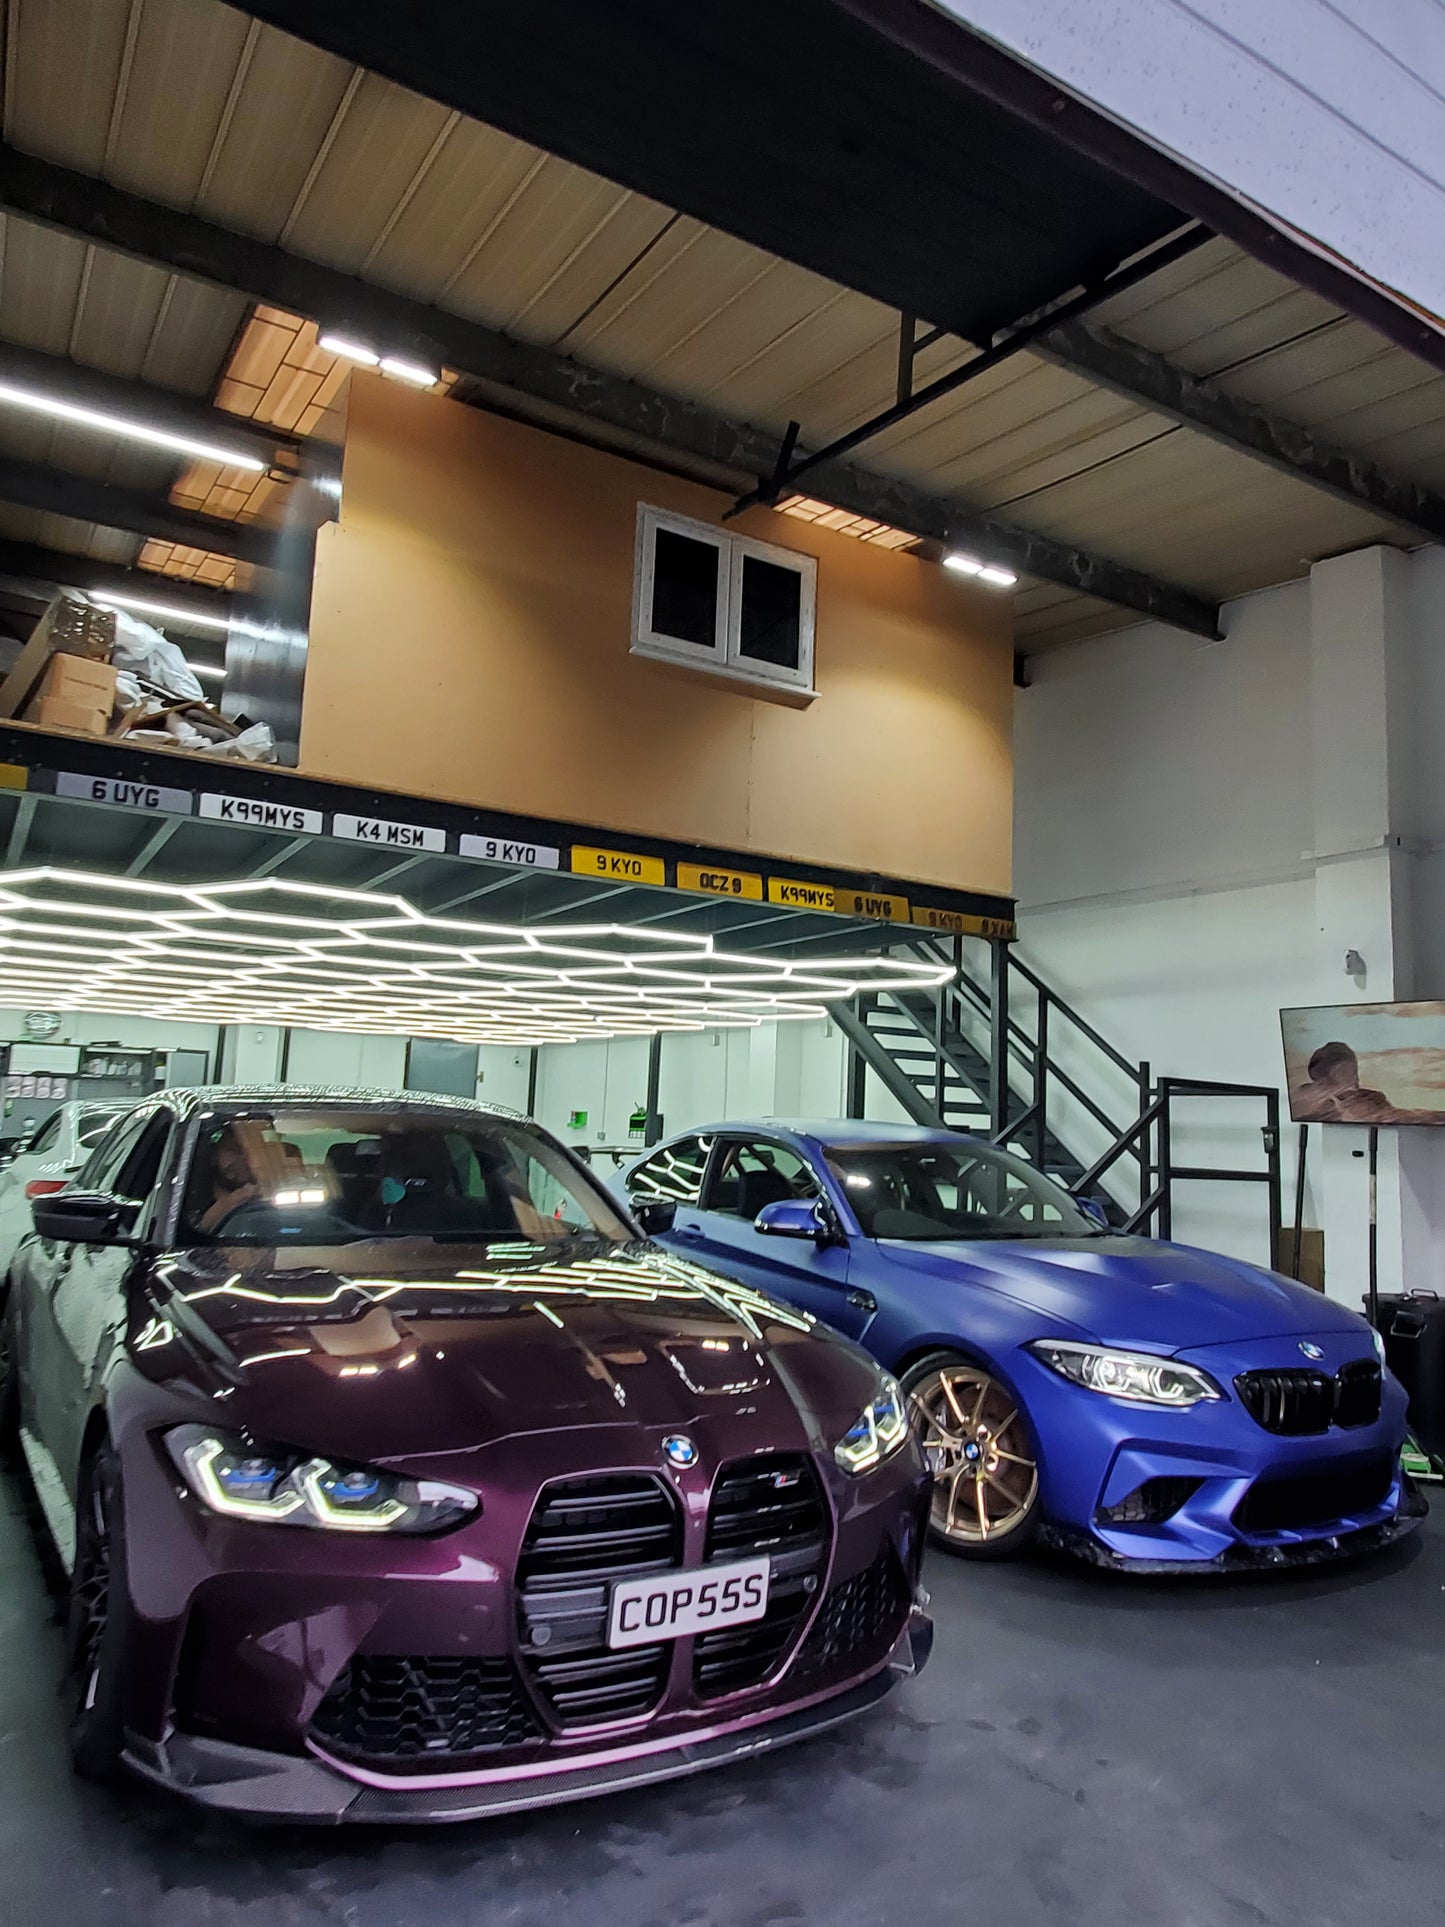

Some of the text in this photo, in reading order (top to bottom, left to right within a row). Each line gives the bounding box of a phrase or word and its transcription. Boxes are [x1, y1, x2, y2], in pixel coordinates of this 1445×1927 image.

[91, 780, 161, 808] 6 UYG
[220, 798, 305, 829] K99MYS
[356, 820, 424, 847] K4 MSM
[485, 841, 497, 858] 9
[596, 854, 607, 870] 9
